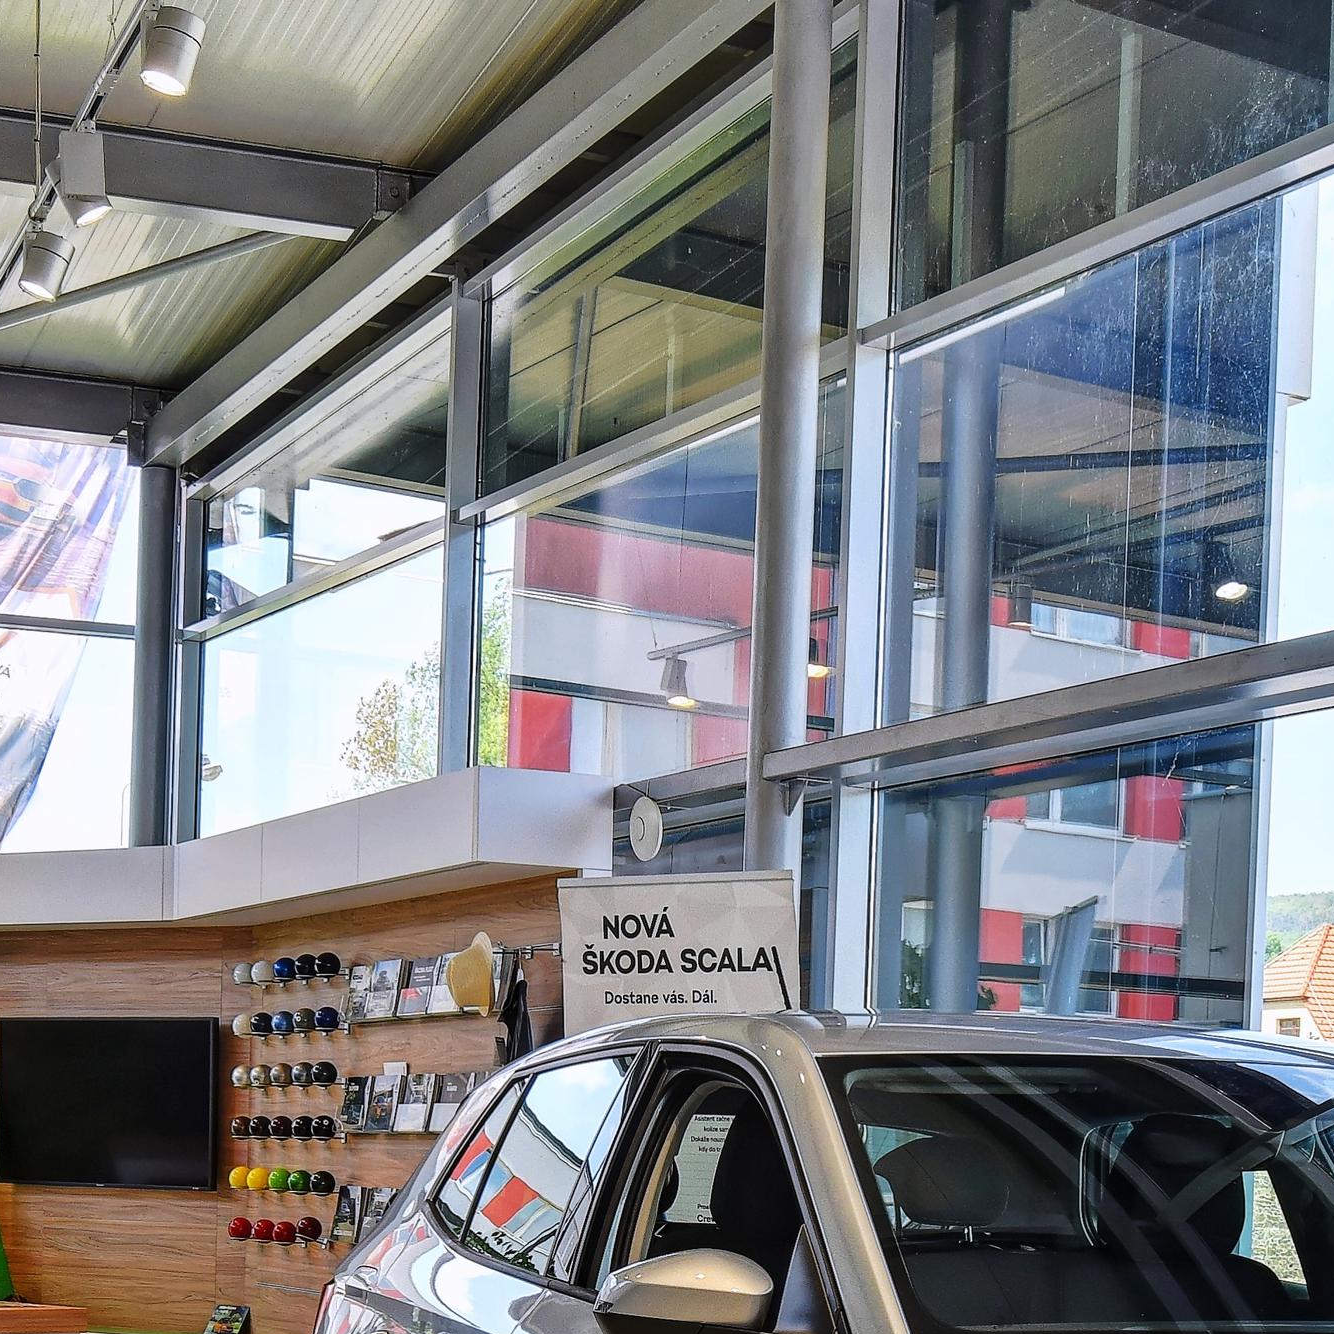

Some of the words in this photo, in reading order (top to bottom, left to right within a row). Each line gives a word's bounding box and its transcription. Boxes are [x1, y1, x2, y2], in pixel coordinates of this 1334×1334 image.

[603, 906, 676, 940] NOVÁ
[582, 944, 675, 976] ŠKODA
[680, 945, 774, 974] SCALA
[604, 991, 659, 1005] Dostane
[662, 990, 688, 1004] vás.
[692, 990, 718, 1004] Dál.
